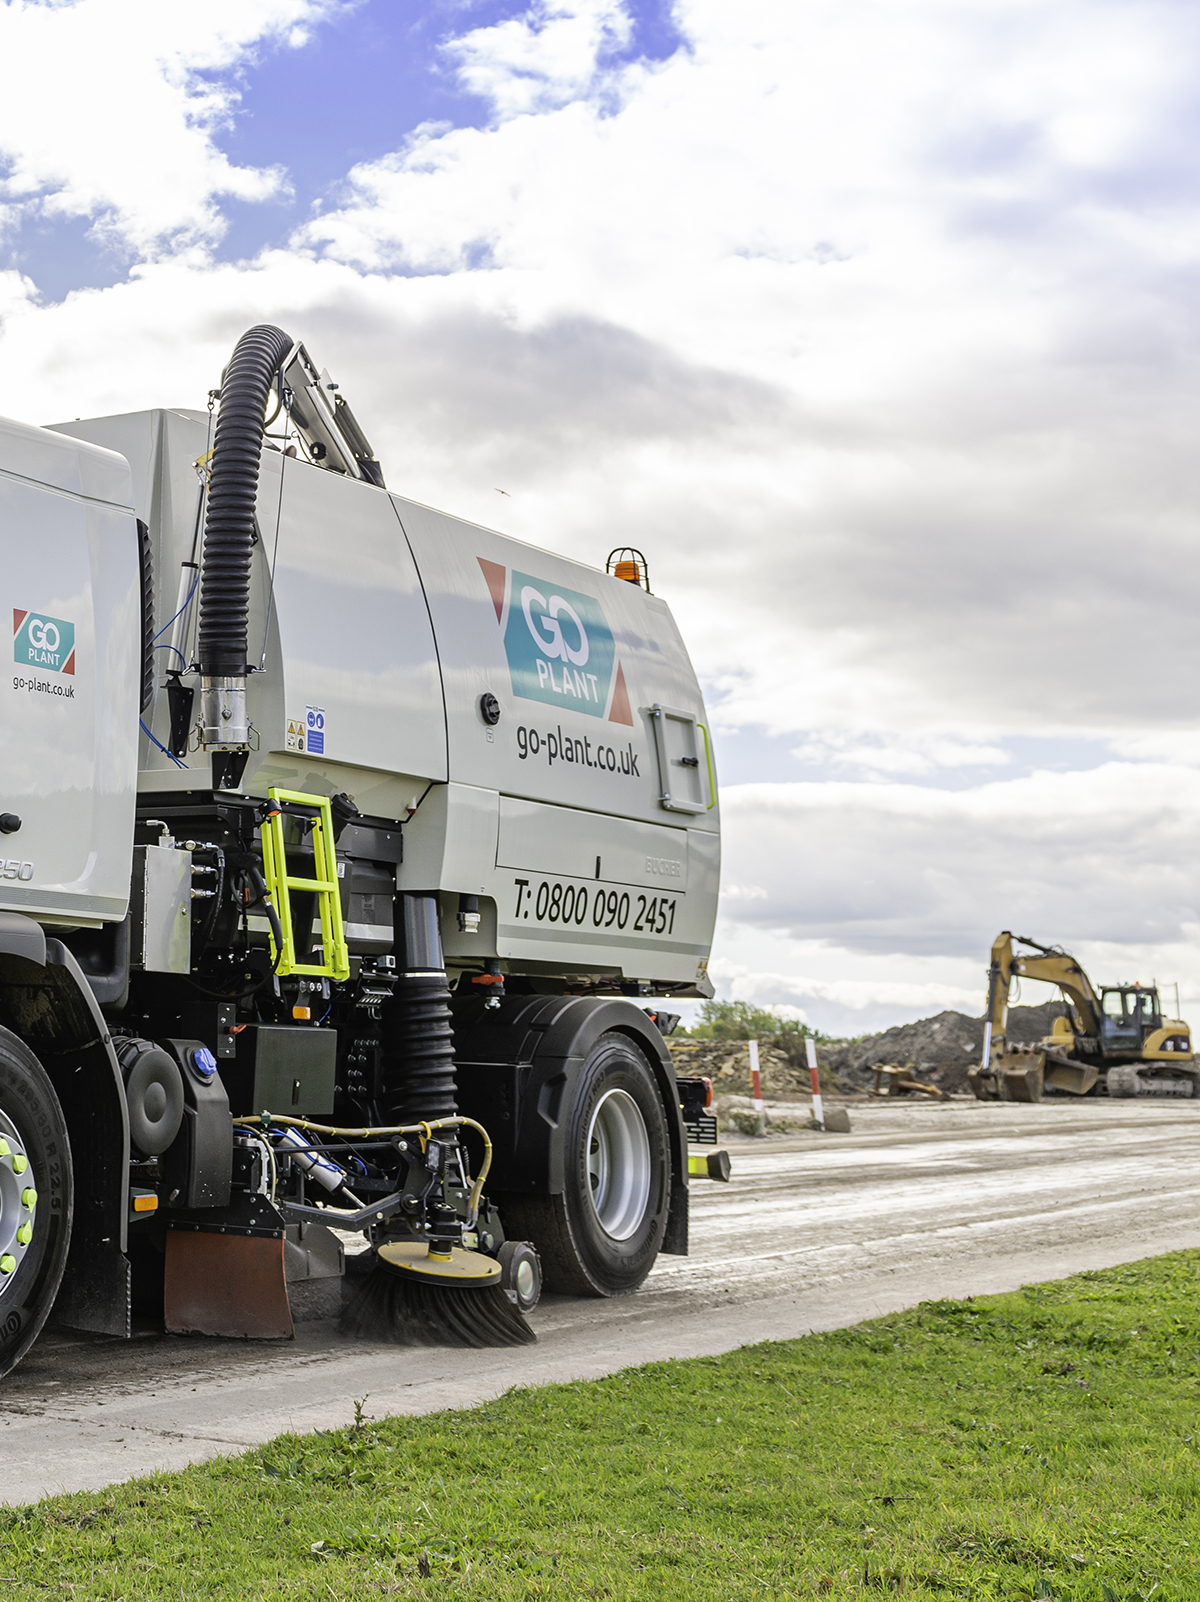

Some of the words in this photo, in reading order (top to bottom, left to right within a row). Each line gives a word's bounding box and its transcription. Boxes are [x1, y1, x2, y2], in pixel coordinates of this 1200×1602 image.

[28, 618, 60, 652] GO
[520, 585, 590, 667] GO
[28, 647, 61, 666] PLANT
[13, 677, 75, 699] go-plant.co.uk
[535, 658, 599, 704] PLANT
[516, 725, 641, 778] go-plant.co.uk
[645, 856, 681, 878] BUCHER
[514, 878, 532, 920] T:
[535, 881, 589, 926] 0800
[592, 888, 631, 931] 090
[633, 894, 676, 935] 2451
